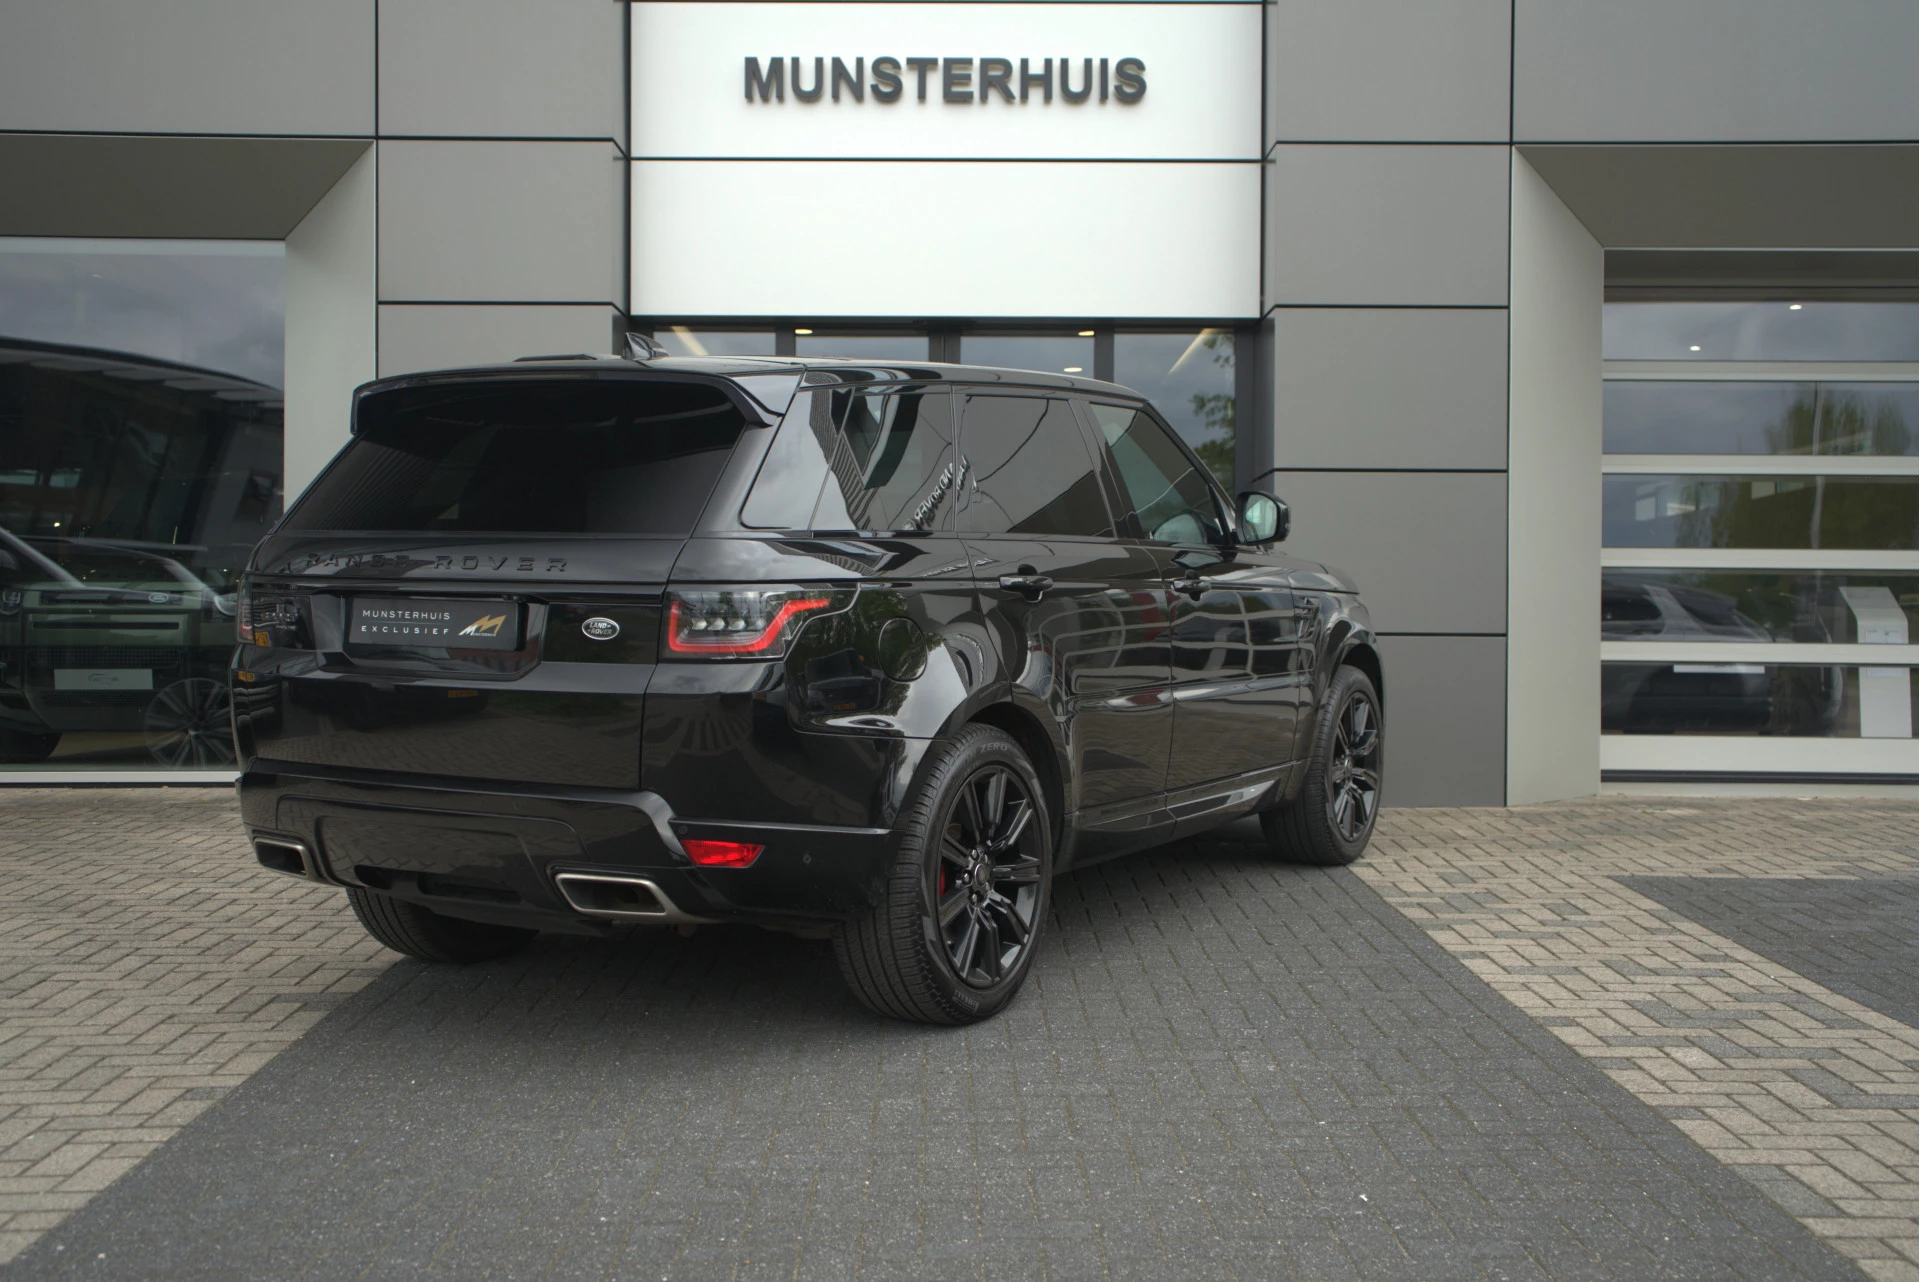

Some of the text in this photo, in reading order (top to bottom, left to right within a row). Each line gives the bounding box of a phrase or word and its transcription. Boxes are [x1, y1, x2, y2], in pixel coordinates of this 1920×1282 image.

[744, 56, 1147, 104] MUNSTERHUIS
[434, 556, 568, 573] ROVER
[362, 610, 450, 620] MUNSTERHUIS
[361, 625, 450, 635] EXCLUSIEF
[980, 742, 1008, 754] ZERO
